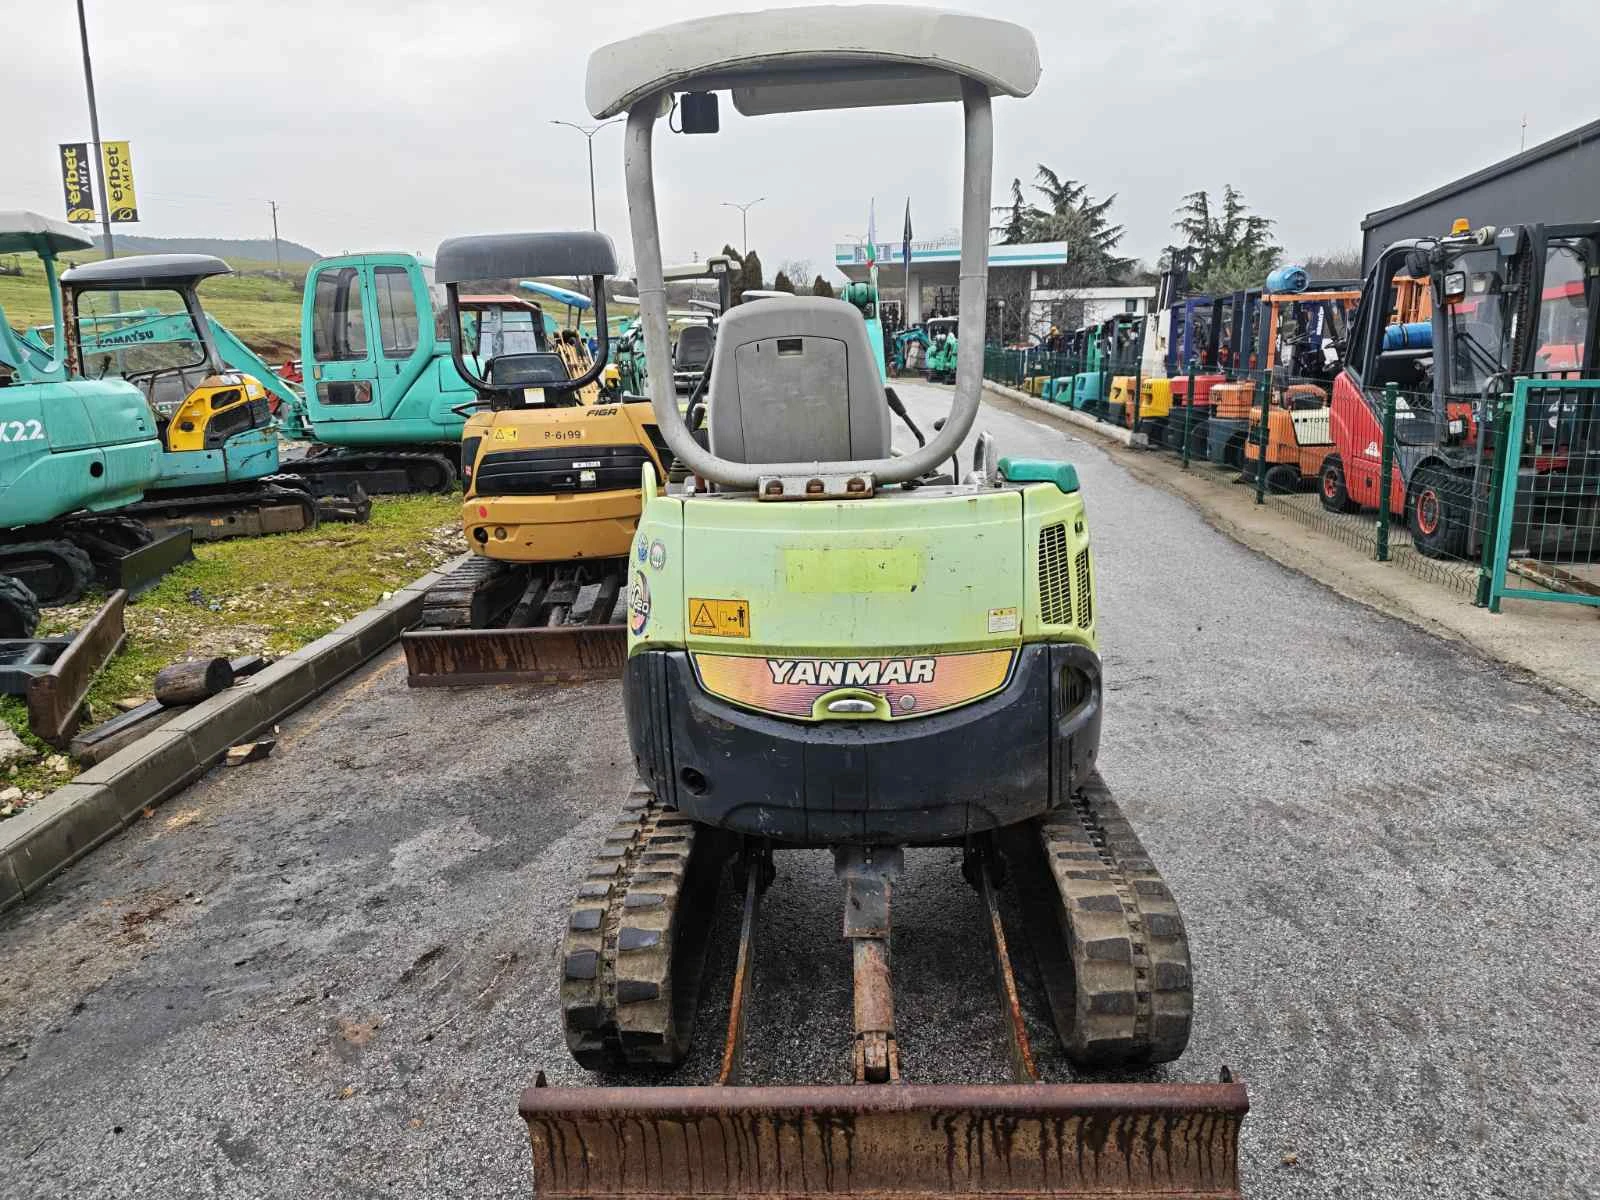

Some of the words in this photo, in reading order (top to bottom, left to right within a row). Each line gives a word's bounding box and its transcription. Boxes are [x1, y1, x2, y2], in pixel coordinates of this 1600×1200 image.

[64, 148, 81, 205] efbet
[107, 146, 123, 202] efbet
[767, 659, 936, 686] YANMAR
